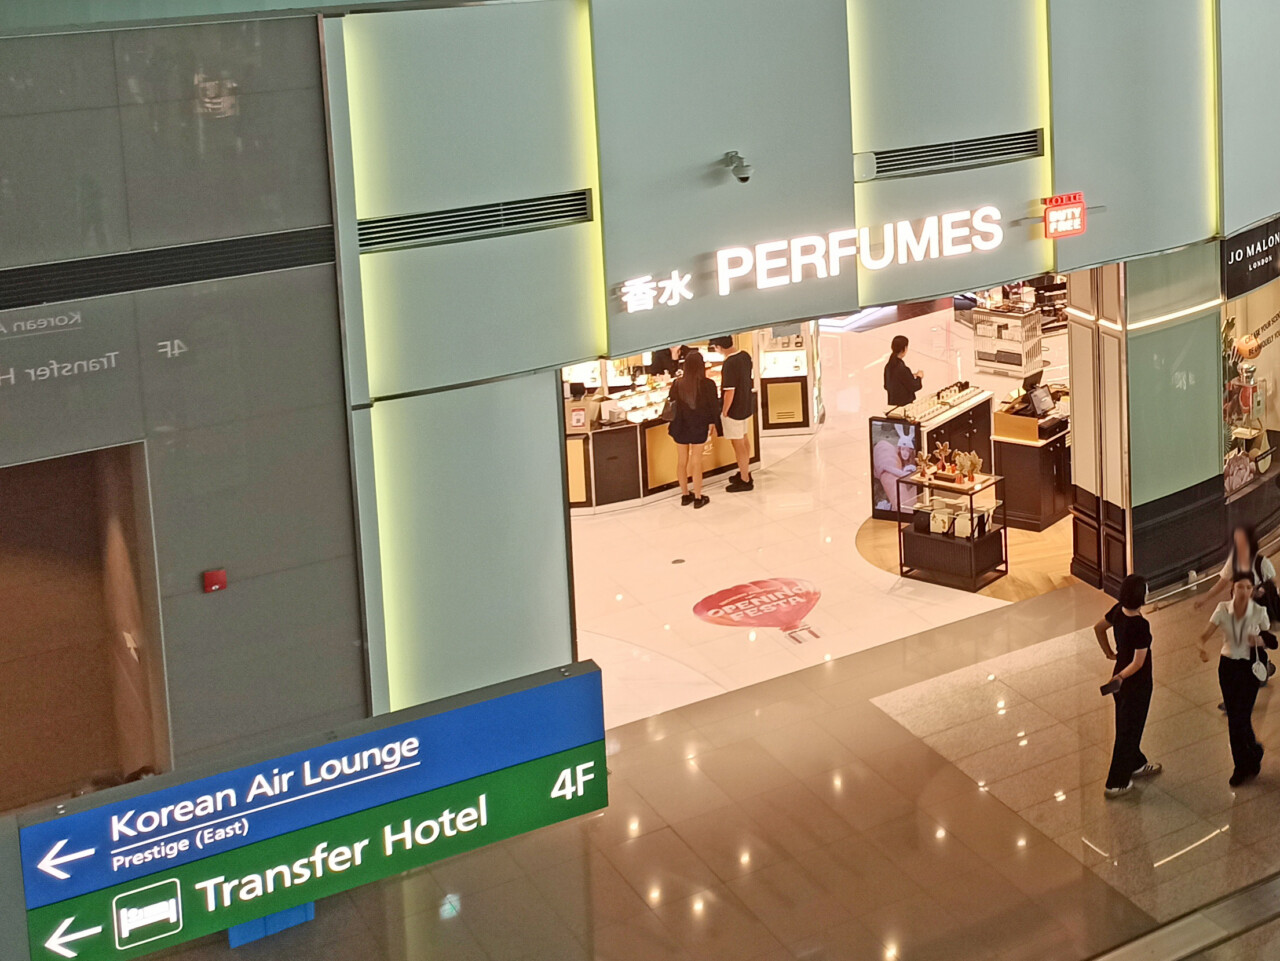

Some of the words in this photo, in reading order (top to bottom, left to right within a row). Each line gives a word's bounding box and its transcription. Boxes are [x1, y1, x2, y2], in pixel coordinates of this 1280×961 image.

[1046, 193, 1083, 206] LOTTE
[1049, 207, 1082, 222] DUTY
[1049, 218, 1082, 234] FREE
[621, 270, 694, 313] 香水
[716, 206, 1004, 296] PERFUMES
[1228, 249, 1244, 265] JO
[1248, 256, 1273, 271] LONDON
[707, 585, 806, 617] OPENING
[730, 596, 806, 621] FESTA
[110, 788, 237, 842] Korean
[246, 768, 295, 802] Air
[304, 737, 420, 786] Lounge
[112, 838, 190, 871] Prestige
[195, 818, 249, 849] (East)
[195, 838, 371, 913] Transfer
[383, 794, 488, 856] Hotel
[550, 761, 596, 800] 4F
